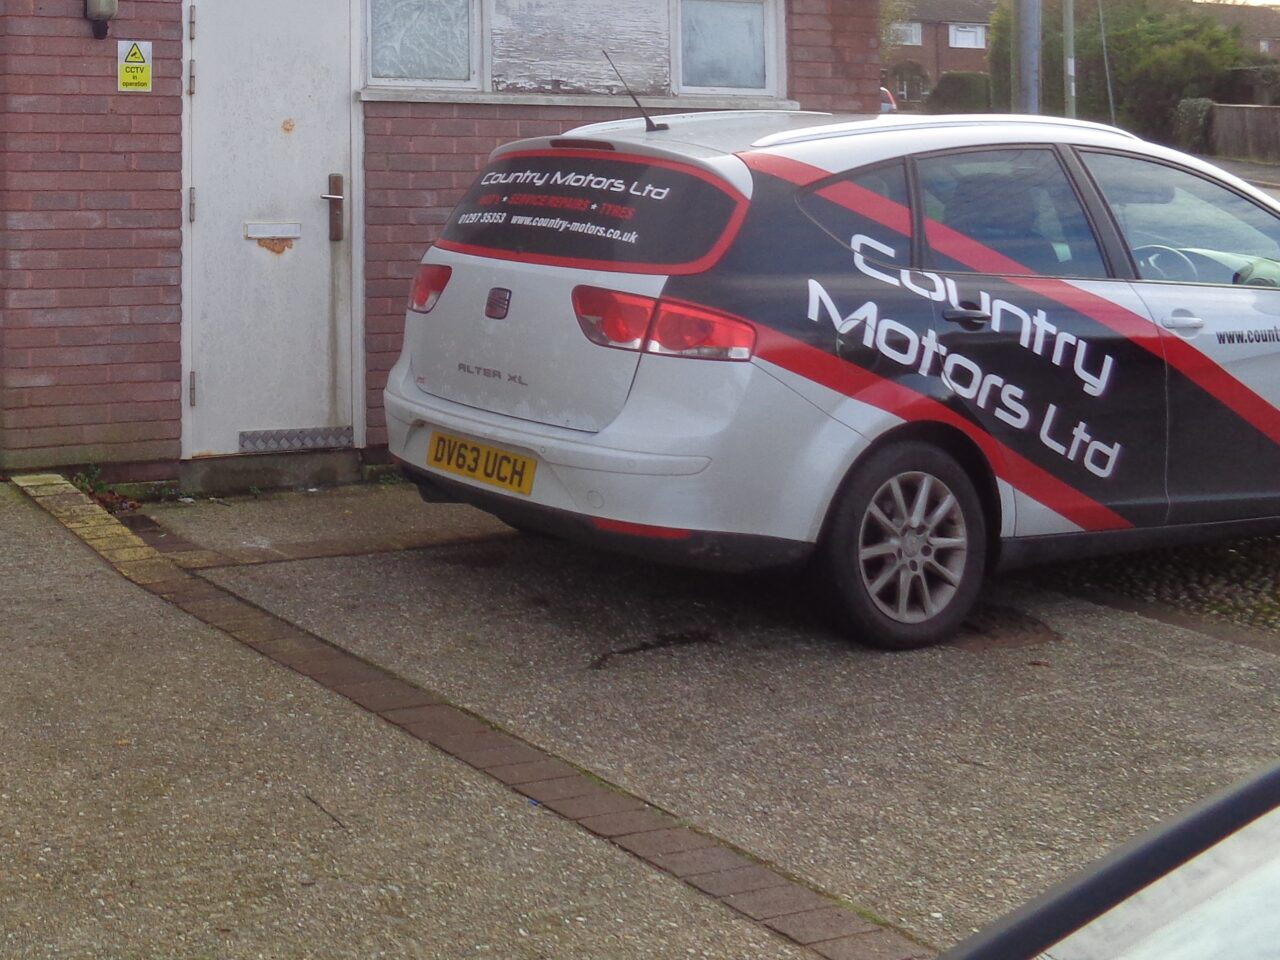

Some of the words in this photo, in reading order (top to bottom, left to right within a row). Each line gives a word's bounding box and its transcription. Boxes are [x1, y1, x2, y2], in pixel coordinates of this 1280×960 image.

[125, 66, 145, 74] CCTV
[481, 169, 549, 186] Country
[550, 171, 626, 192] Motors
[629, 181, 670, 200] Ltd
[599, 202, 637, 220] TYRES
[480, 212, 507, 224] 35353
[510, 215, 639, 243] www.country-motors.co.uk
[850, 233, 1114, 398] Country
[507, 373, 529, 387] XL
[807, 278, 1031, 430] Motors
[1039, 403, 1122, 479] Ltd
[434, 436, 481, 473] DV63
[483, 450, 526, 488] UCH
